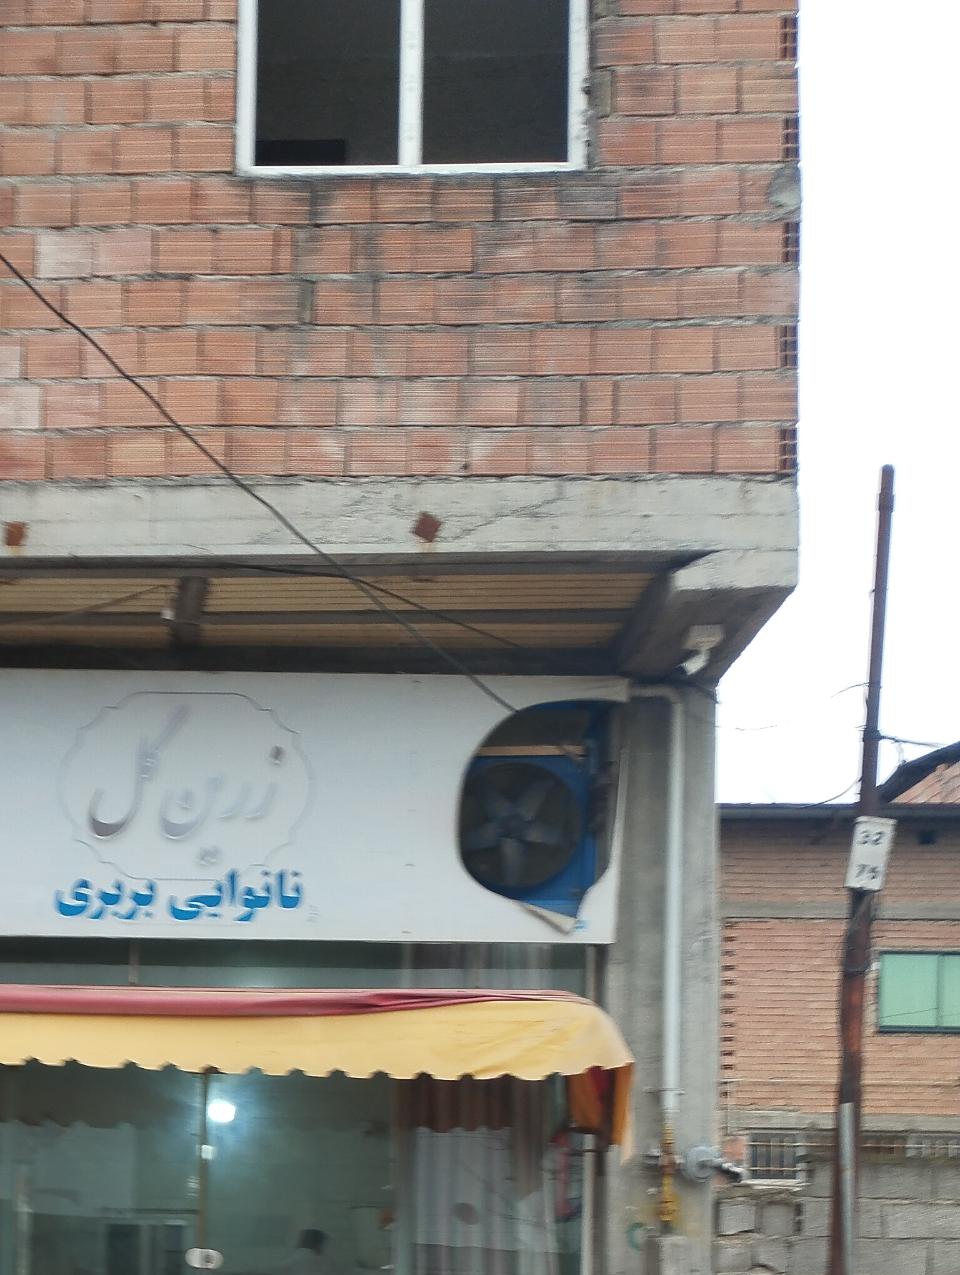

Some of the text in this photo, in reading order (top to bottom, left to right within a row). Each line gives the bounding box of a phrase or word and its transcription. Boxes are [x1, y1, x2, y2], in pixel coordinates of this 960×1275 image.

[89, 704, 287, 868] زرین گل
[54, 868, 302, 922] نانوایی بربری
